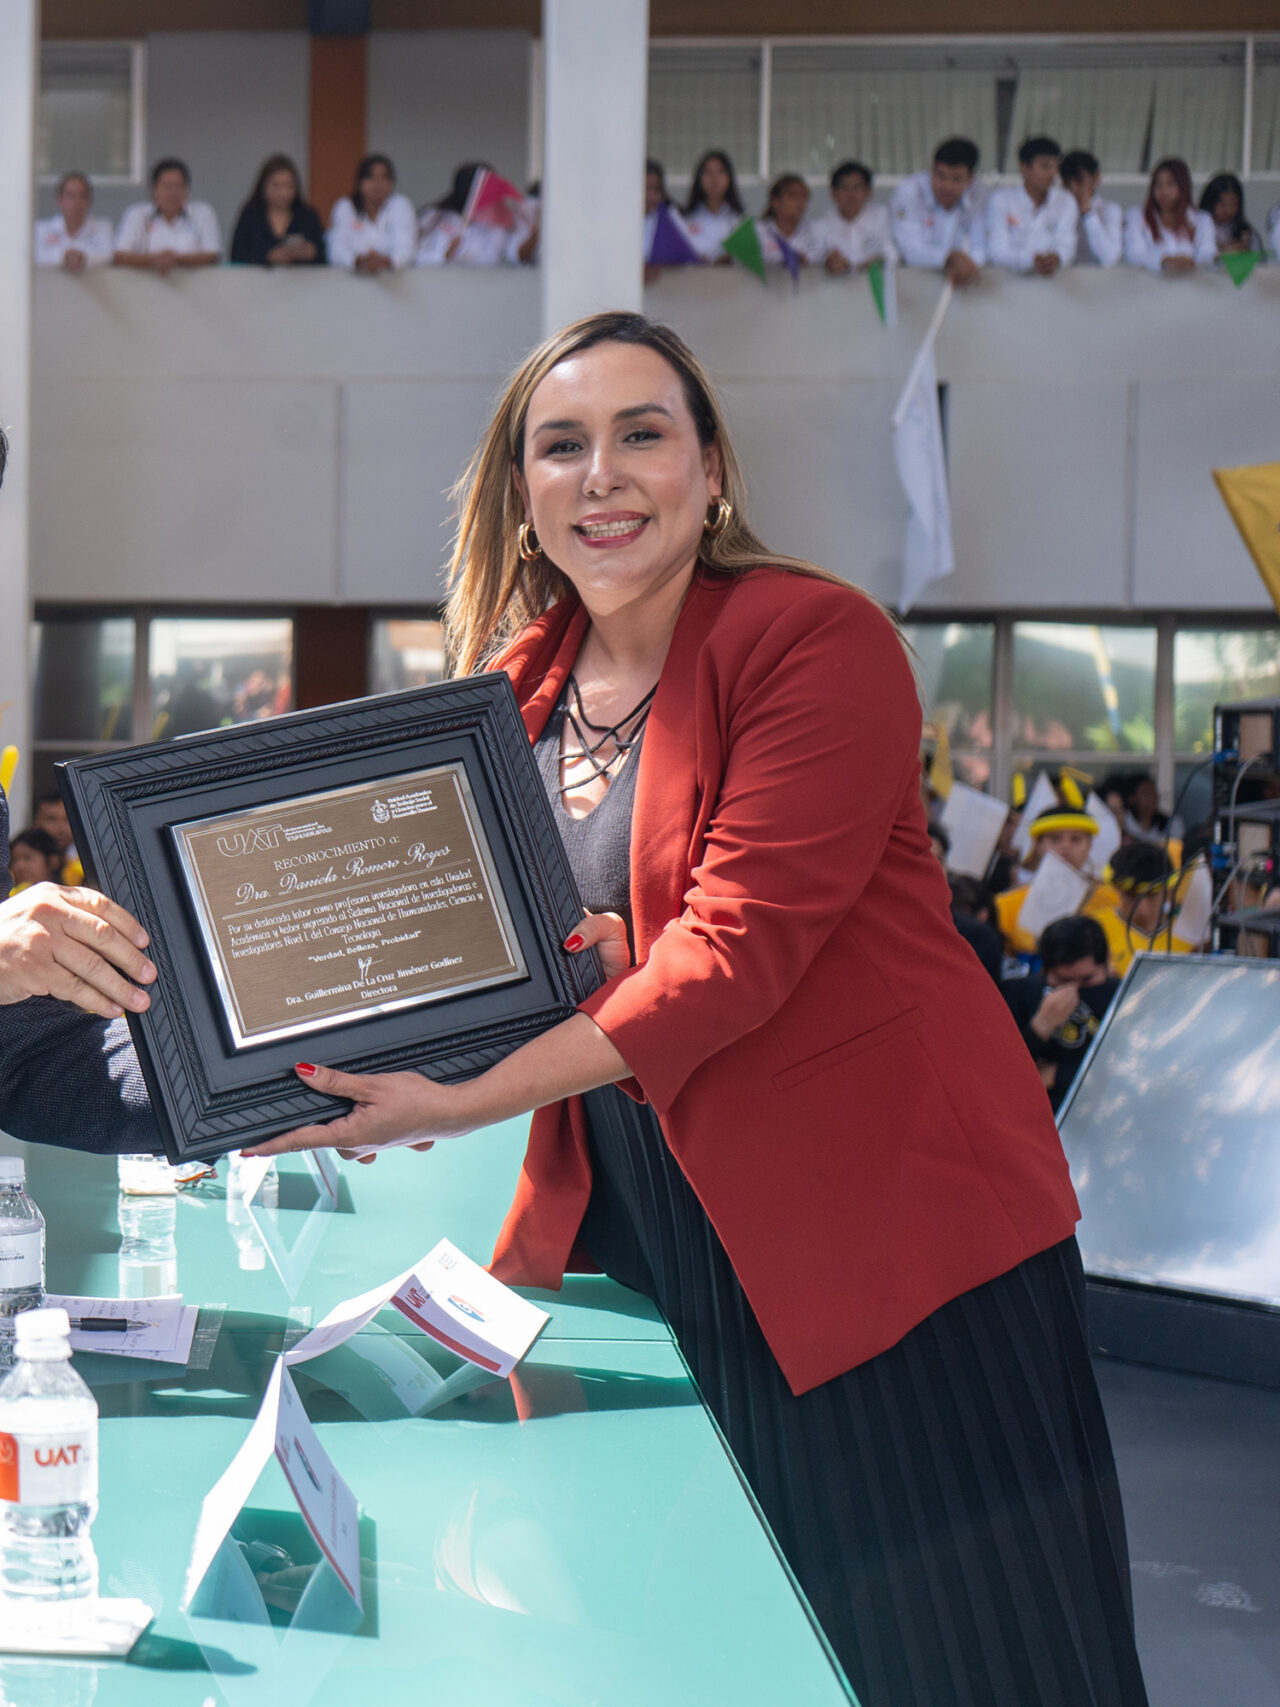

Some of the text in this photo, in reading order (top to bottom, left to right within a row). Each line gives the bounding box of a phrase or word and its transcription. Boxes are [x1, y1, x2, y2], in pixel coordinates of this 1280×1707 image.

[216, 824, 280, 857] UAT
[274, 836, 400, 871] RECONOCIMIENTO a:
[235, 842, 451, 905] Dra. Daniela Romero Reyes
[228, 925, 241, 935] Por
[254, 913, 291, 928] destacada
[292, 908, 311, 919] labor
[313, 904, 333, 914] como
[334, 896, 370, 913] profesora
[371, 884, 418, 903] investigadora
[419, 881, 429, 889] en
[430, 876, 445, 886] esta
[445, 868, 472, 882] Unidad
[232, 940, 283, 958] Investigadores
[283, 933, 303, 946] Nivel
[310, 929, 323, 939] del
[323, 923, 352, 936] Consejo
[353, 913, 386, 929] Nacional
[387, 912, 397, 921] de
[449, 894, 476, 906] Ciencia
[477, 893, 483, 901] y
[272, 930, 279, 938] y
[279, 924, 300, 934] haber
[302, 915, 337, 929] ingresado
[339, 911, 347, 920] al
[347, 906, 377, 918] Sistema
[377, 895, 410, 911] Nacional
[411, 894, 420, 903] de
[421, 883, 472, 900] Investigadoras
[286, 956, 464, 1006] Dra. Guillermina De La Cruz Jiménez Godínez
[360, 985, 398, 999] Directora
[34, 1443, 82, 1468] UAT
